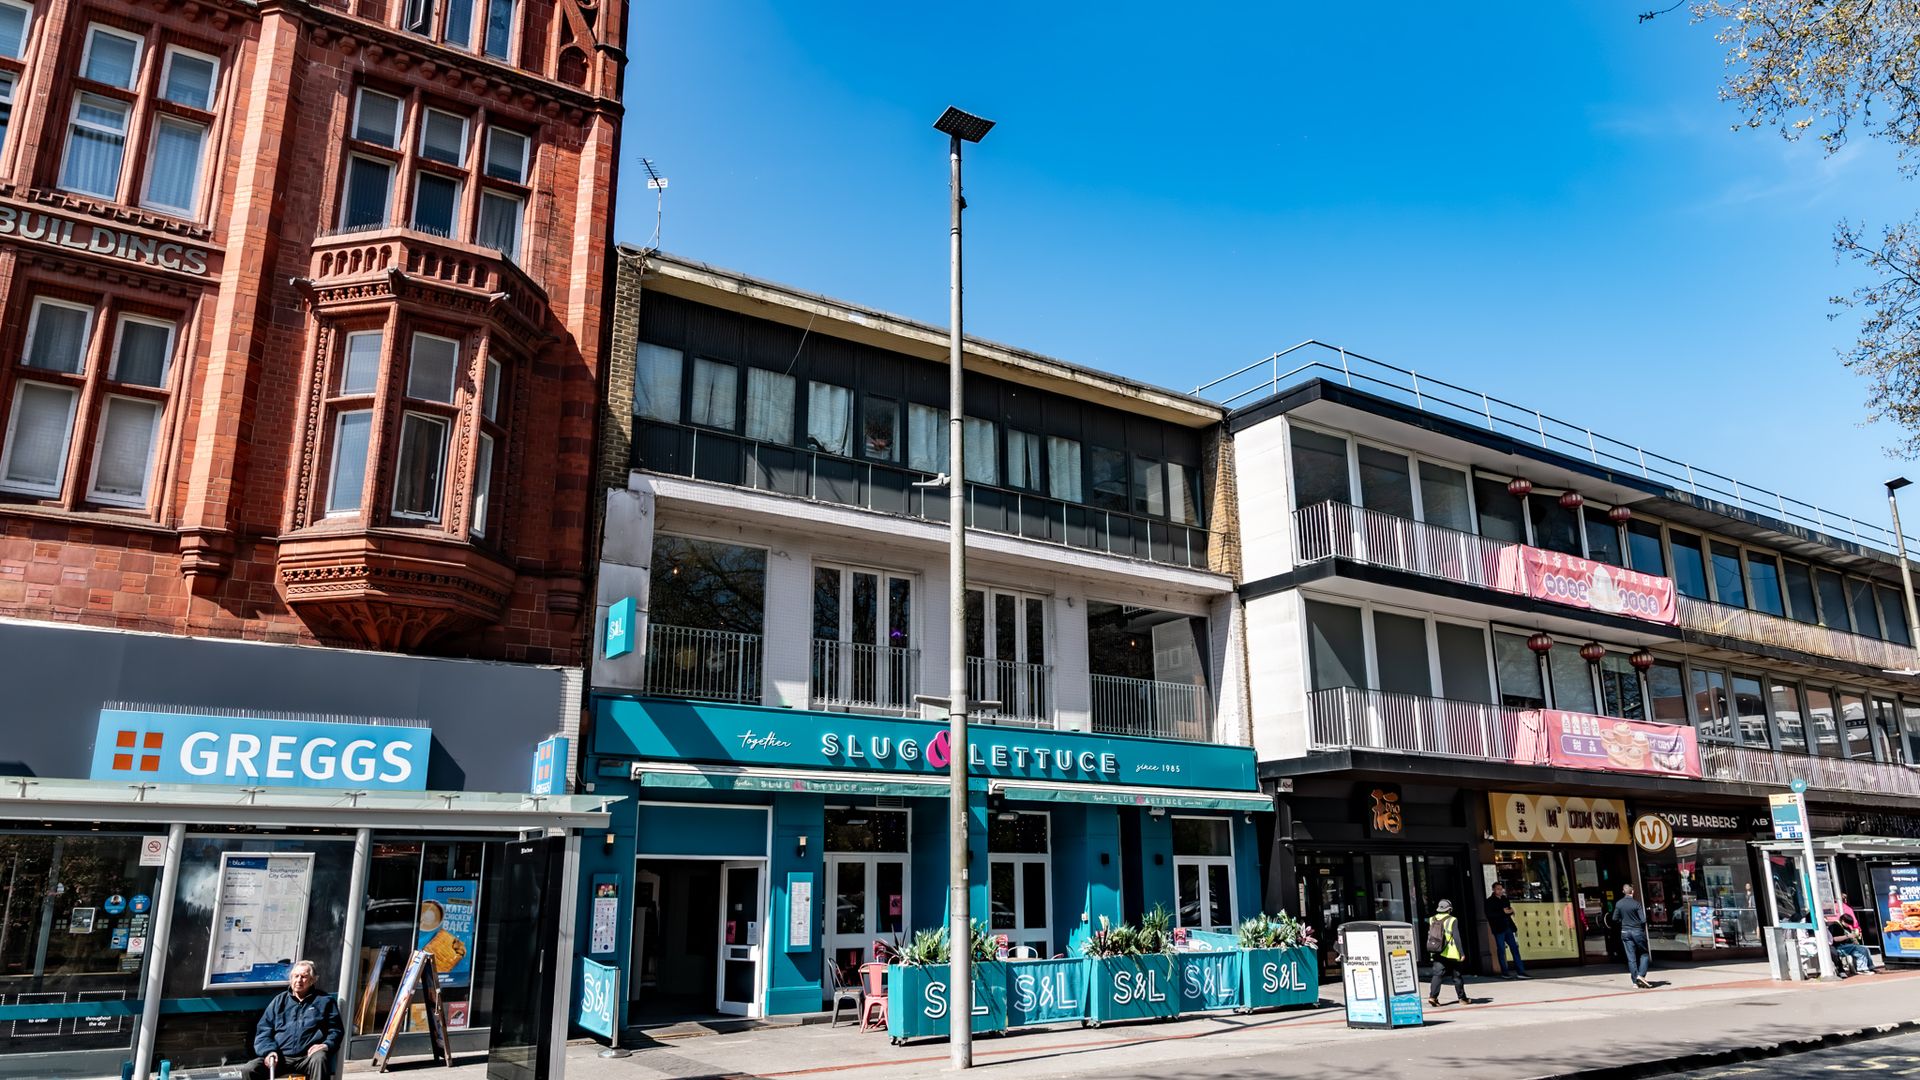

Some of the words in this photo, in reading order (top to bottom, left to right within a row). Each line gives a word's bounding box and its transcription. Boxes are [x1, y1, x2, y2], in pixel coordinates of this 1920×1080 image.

[0, 207, 208, 275] BUILDINGS
[608, 617, 625, 640] S&L
[180, 731, 413, 783] GREGGS
[737, 729, 792, 750] together
[822, 733, 918, 762] SLUG
[926, 729, 951, 768] &
[970, 743, 1116, 774] LETTUCE
[1135, 763, 1159, 774] since
[1162, 764, 1181, 773] 1985
[760, 781, 790, 789] SLUG
[792, 779, 806, 792] &
[806, 781, 857, 792] LETTUCE
[1113, 795, 1134, 803] SLUG
[1145, 797, 1182, 806] LETTUCE
[1594, 811, 1621, 830] SUM
[1692, 815, 1738, 829] BARBERS
[442, 920, 470, 932] BAKE
[445, 914, 471, 922] CHICKEN
[446, 904, 472, 914] KATSU
[1013, 972, 1078, 1012] S&L
[1113, 969, 1166, 1004] S&L
[1184, 963, 1235, 999] S&L
[1262, 961, 1307, 995] S&L
[582, 973, 610, 1022] S&L
[924, 982, 989, 1018] SL
